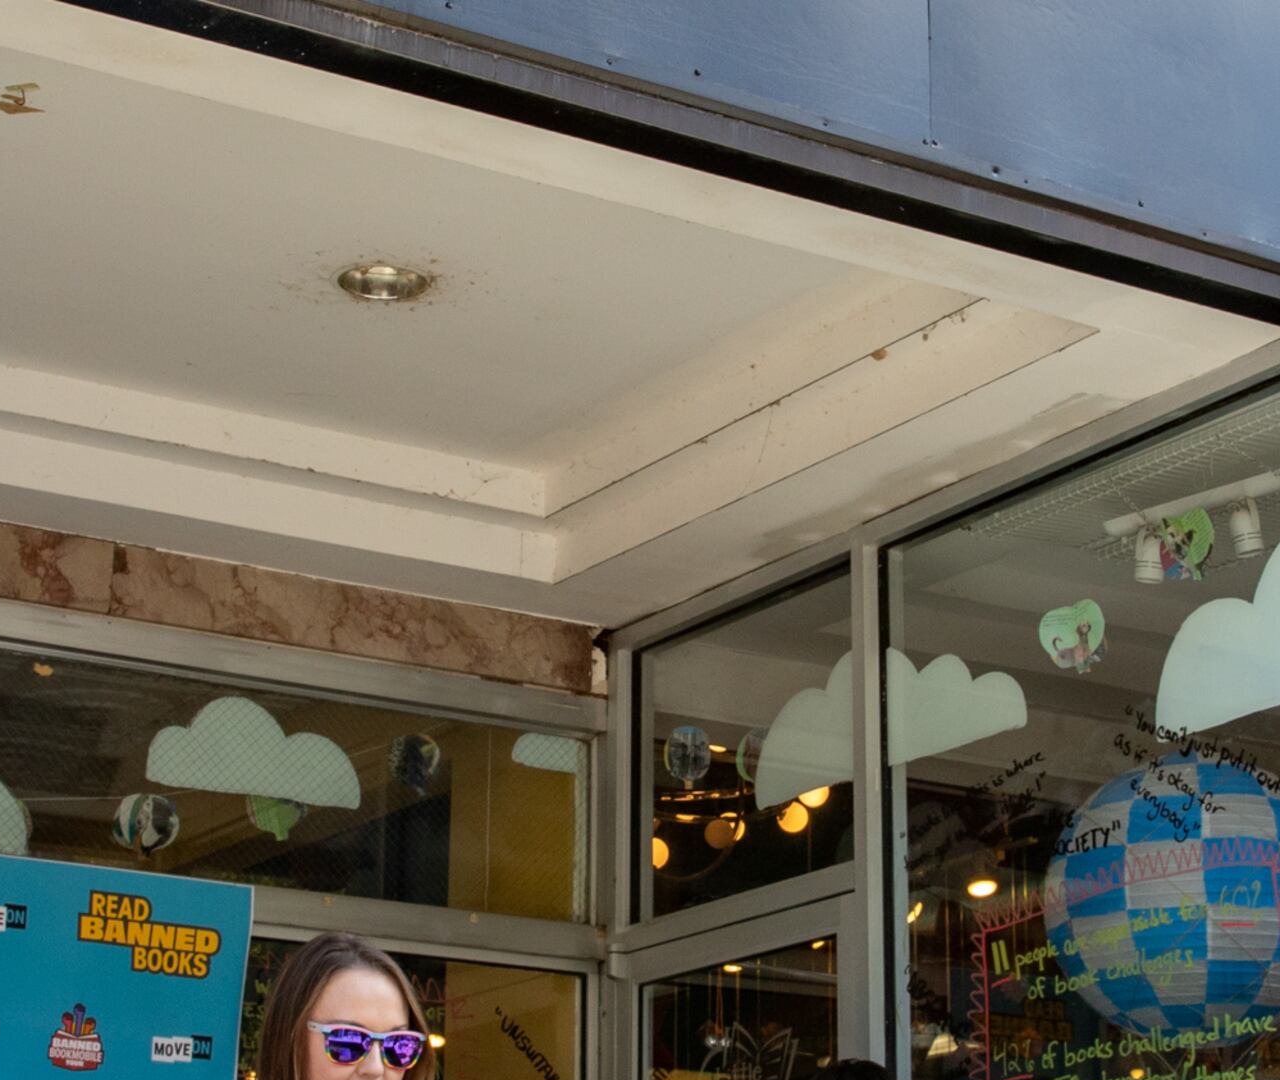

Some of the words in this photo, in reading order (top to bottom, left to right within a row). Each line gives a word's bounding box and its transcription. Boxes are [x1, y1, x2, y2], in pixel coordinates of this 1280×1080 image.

[92, 893, 149, 921] READ
[80, 917, 219, 954] BANNED
[133, 948, 208, 976] BOOKS
[1027, 980, 1046, 999] of
[1063, 1040, 1113, 1068] books
[1119, 1019, 1219, 1068] challenged
[1225, 1015, 1277, 1035] have
